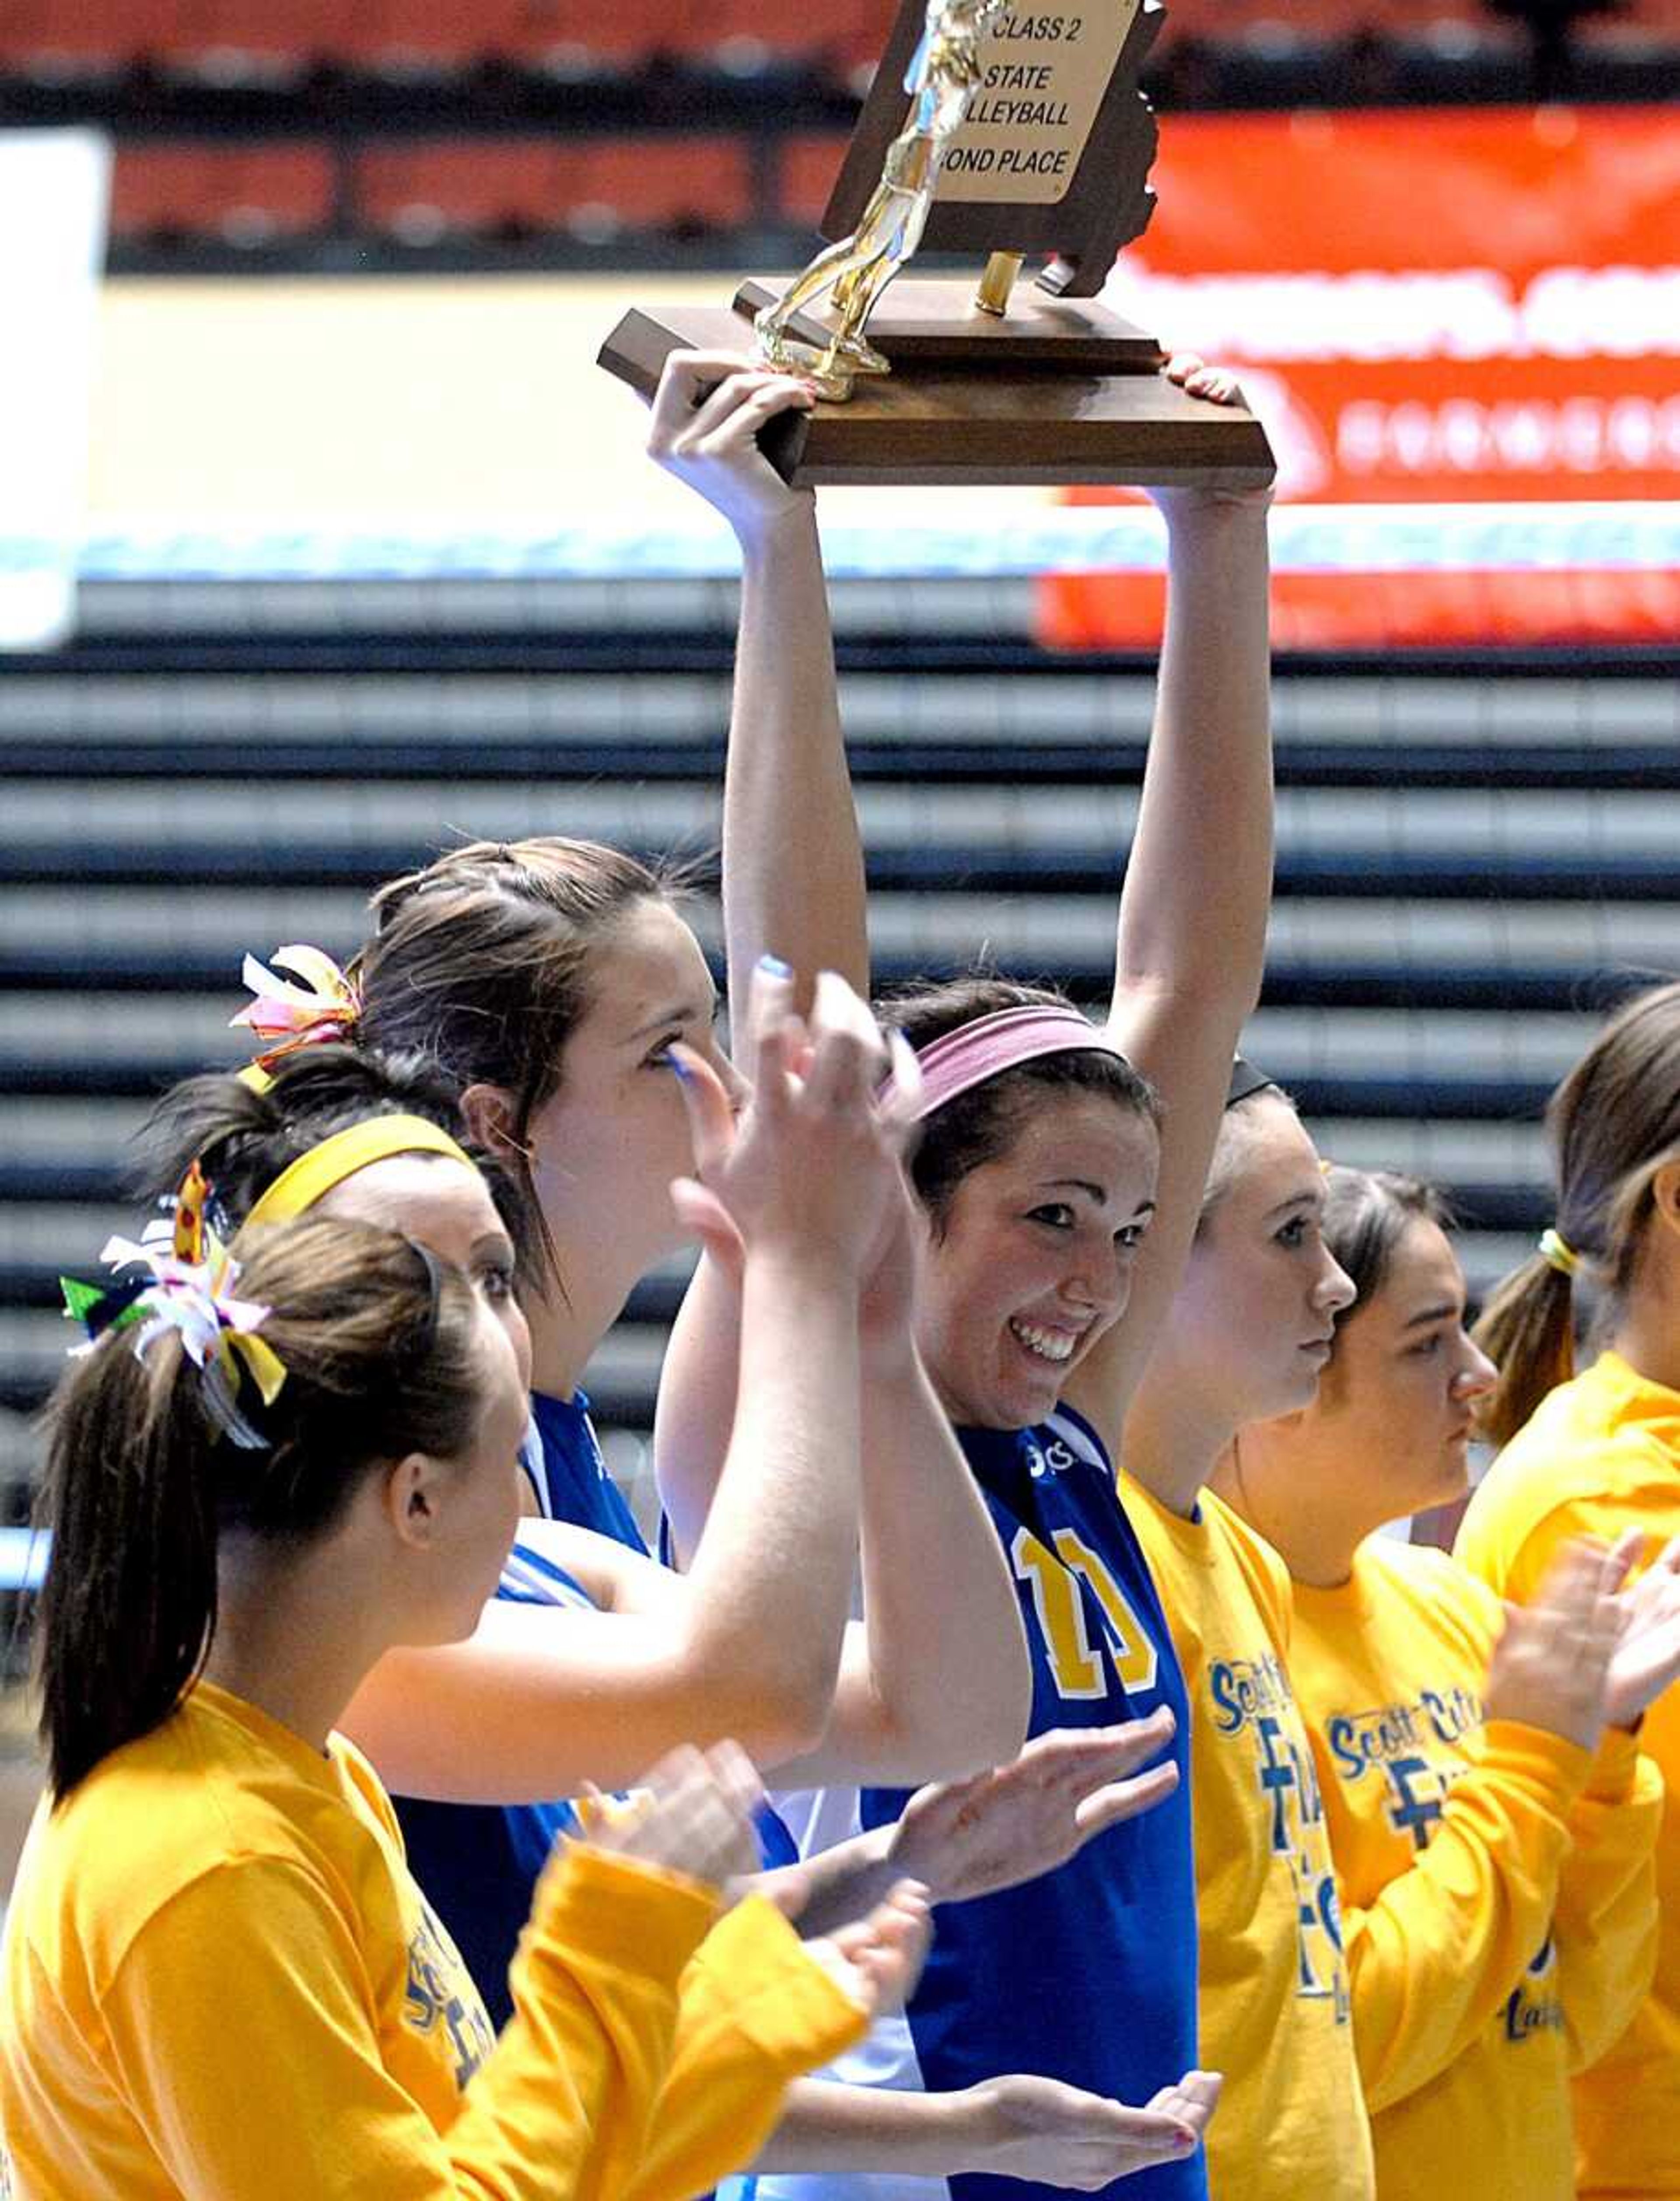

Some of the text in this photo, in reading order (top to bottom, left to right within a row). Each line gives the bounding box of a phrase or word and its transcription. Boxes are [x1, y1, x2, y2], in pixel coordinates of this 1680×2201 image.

[992, 15, 1082, 41] CLASS 2
[984, 64, 1053, 89] STATE
[965, 100, 1069, 125] LLEYBALL
[941, 148, 1071, 174] OND PLACE
